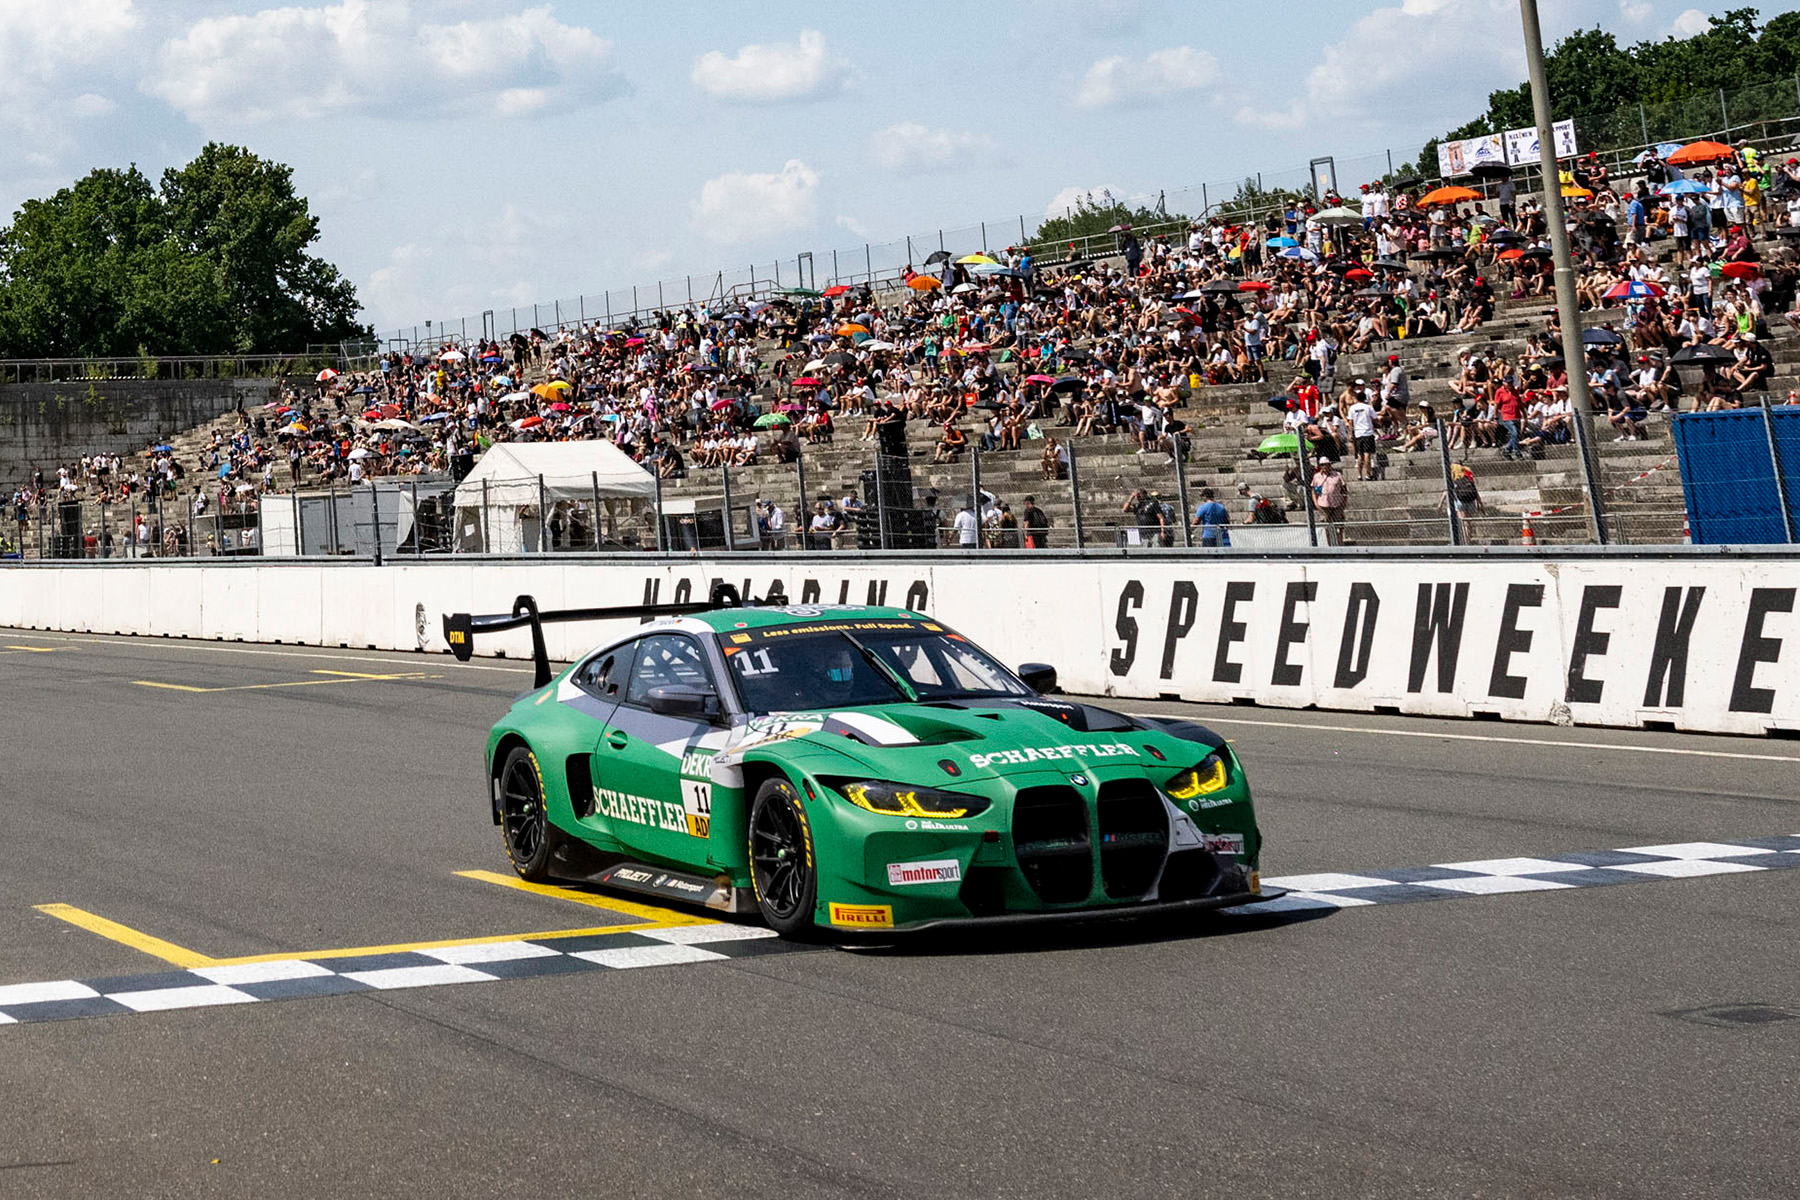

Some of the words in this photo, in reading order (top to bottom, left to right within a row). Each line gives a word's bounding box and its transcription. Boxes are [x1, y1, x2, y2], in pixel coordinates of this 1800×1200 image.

[449, 631, 465, 644] DTM
[763, 629, 790, 638] Less
[791, 623, 854, 634] emissions.
[854, 622, 877, 630] Full
[879, 622, 915, 631] Speed.
[1110, 580, 1797, 714] SPEEDWEEKE
[735, 649, 779, 676] 11
[681, 752, 711, 778] DEKR
[969, 743, 1141, 768] SCHAEFFLER
[592, 785, 690, 834] SCHAEFFLER
[694, 785, 710, 814] 11
[902, 865, 959, 882] motorsport
[834, 907, 886, 923] PIRELLI
